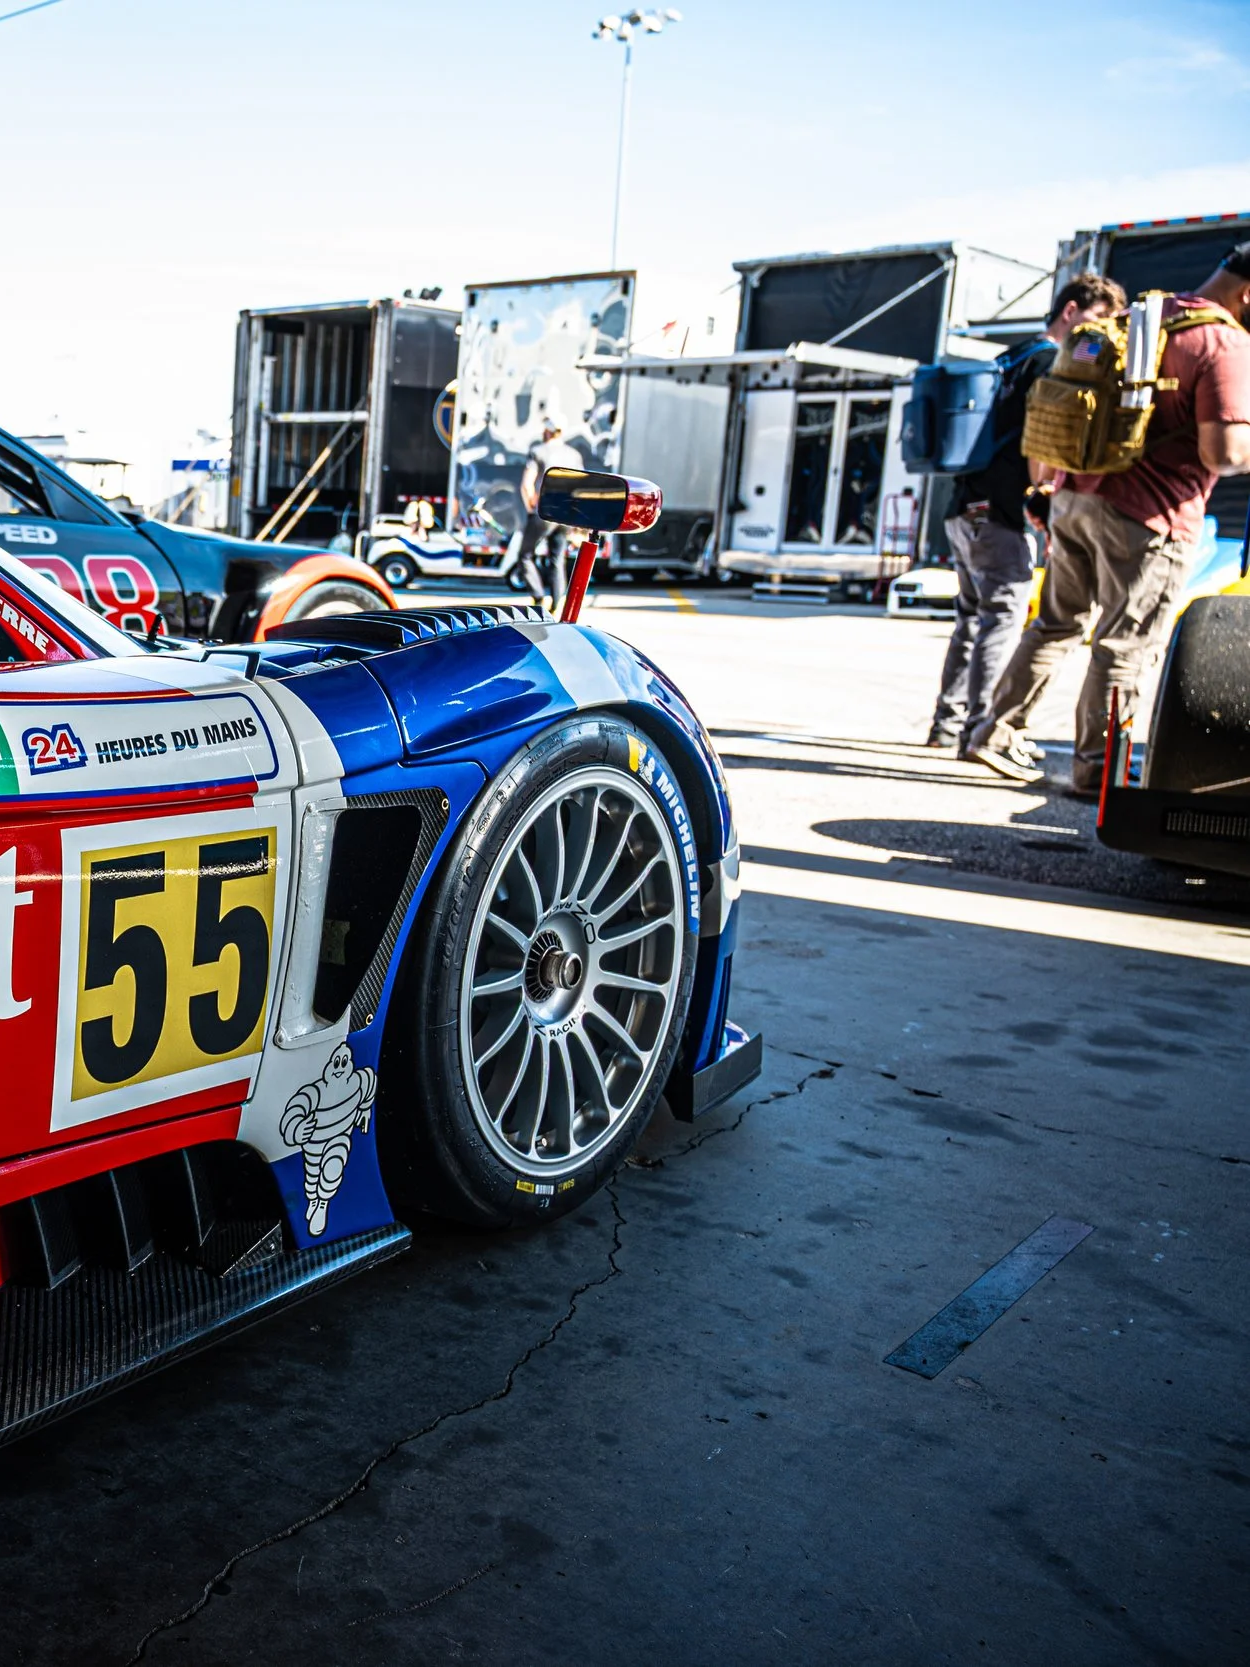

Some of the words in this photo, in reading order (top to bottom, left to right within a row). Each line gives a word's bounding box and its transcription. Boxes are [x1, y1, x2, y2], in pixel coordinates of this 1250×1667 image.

[26, 729, 82, 769] 24
[95, 733, 168, 764] HEURES
[172, 727, 199, 752] DU
[203, 716, 257, 746] MANS
[656, 772, 700, 919] MICHELIN
[81, 835, 270, 1084] 55
